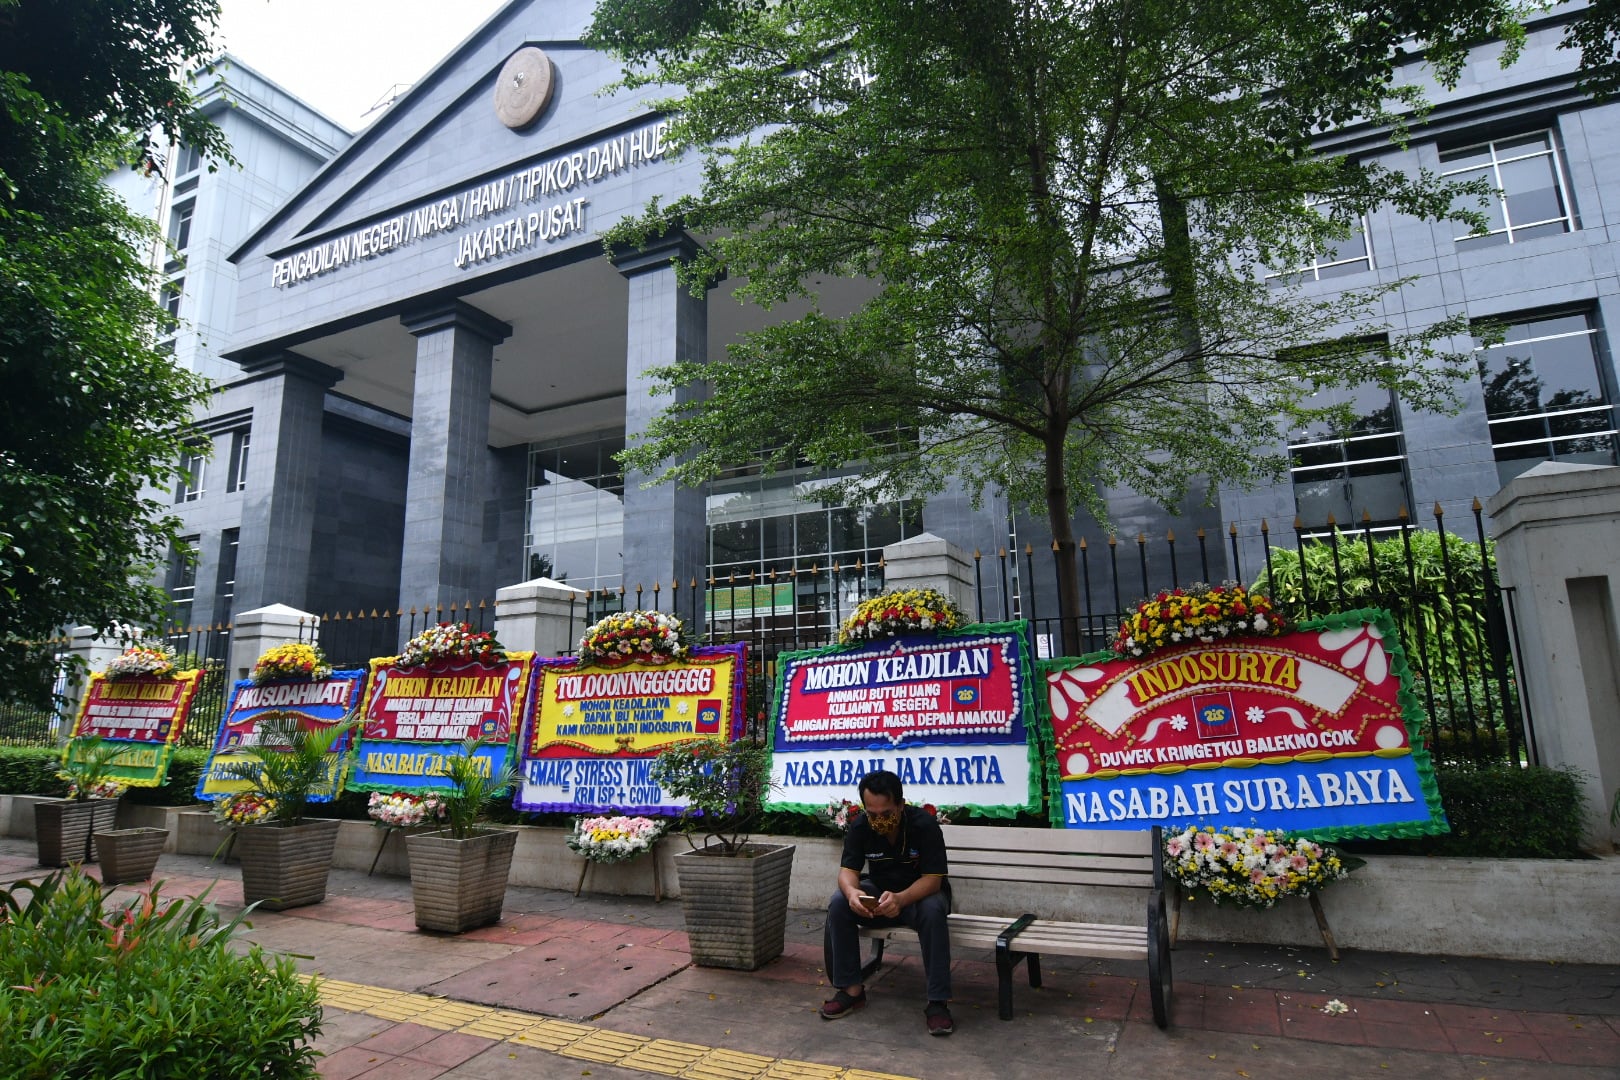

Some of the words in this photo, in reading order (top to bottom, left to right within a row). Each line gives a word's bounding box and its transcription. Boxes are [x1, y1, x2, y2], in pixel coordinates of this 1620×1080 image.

[271, 235, 351, 287] PENGADILAN
[352, 216, 404, 259] NEGERI
[413, 196, 458, 238] NIAGA
[469, 179, 505, 218] HAM
[518, 152, 583, 202] TIPIKOR
[586, 136, 625, 179] DAN
[454, 217, 525, 268] JAKARTA
[527, 197, 586, 244] PUSAT
[805, 660, 871, 691] MOHON
[875, 648, 990, 683] KEADILAN
[1128, 652, 1299, 703] INDOSURYA
[383, 677, 429, 697] MOHON
[429, 676, 504, 698] KEADILAN
[869, 686, 907, 701] BUTUH
[909, 683, 941, 697] UANG
[580, 699, 612, 711] MOHON
[613, 697, 670, 711] KEADILANYA
[584, 710, 612, 722] BAPAK
[615, 710, 630, 722] IBU
[633, 709, 664, 721] HAKIM
[828, 702, 886, 716] KULIAHNYA
[892, 698, 938, 712] SEGERA
[556, 724, 578, 736] KAMI
[579, 723, 615, 735] KORBAN
[617, 722, 638, 734] DARI
[640, 721, 692, 734] INDOSURYA
[790, 718, 829, 732] JANGAN
[829, 716, 880, 730] RENGGUT
[883, 714, 915, 728] MASA
[918, 712, 955, 727] DEPAN
[956, 710, 1006, 725] ANAKKU
[1100, 749, 1155, 768] DUWEK
[1156, 740, 1245, 763] KRINGETKU
[1246, 732, 1319, 755] BALEKNO
[1321, 729, 1358, 748] COK
[365, 752, 426, 775] NASABAH
[574, 760, 622, 786] STRESS
[895, 755, 1005, 785] JAKARTA
[574, 787, 594, 804] KRN
[597, 787, 615, 804] ISP
[630, 787, 662, 804] COVID
[1065, 782, 1220, 824] NASABAH
[1222, 768, 1415, 813] SURABAYA
